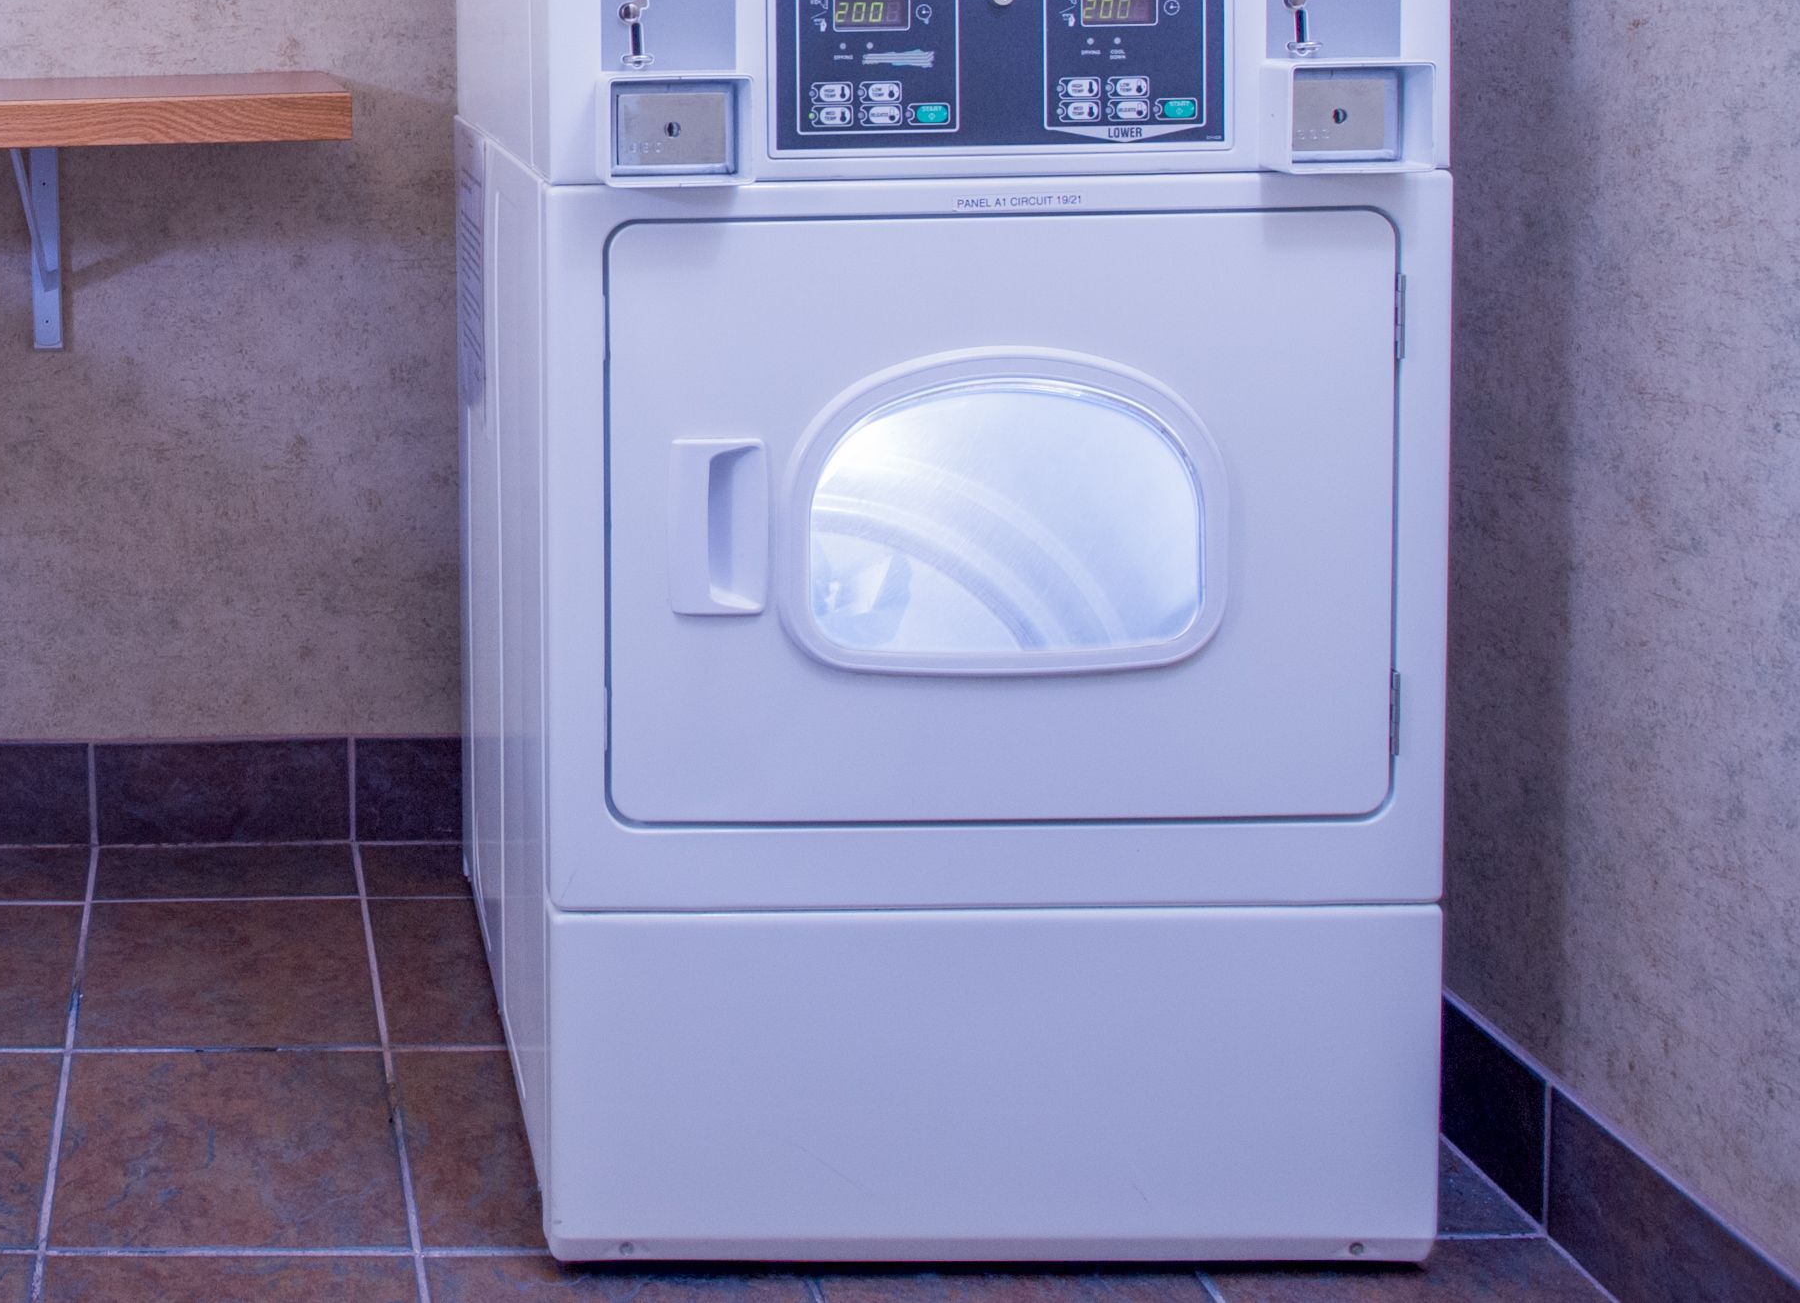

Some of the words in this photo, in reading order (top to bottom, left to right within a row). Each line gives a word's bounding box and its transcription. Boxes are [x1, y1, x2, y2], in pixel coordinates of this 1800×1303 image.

[835, 2, 884, 23] 200
[1108, 127, 1142, 138] LOWER
[957, 198, 991, 208] PANEL
[995, 198, 1006, 207] A1
[1010, 196, 1053, 206] CIRCUIT
[1057, 195, 1081, 204] 19/21
